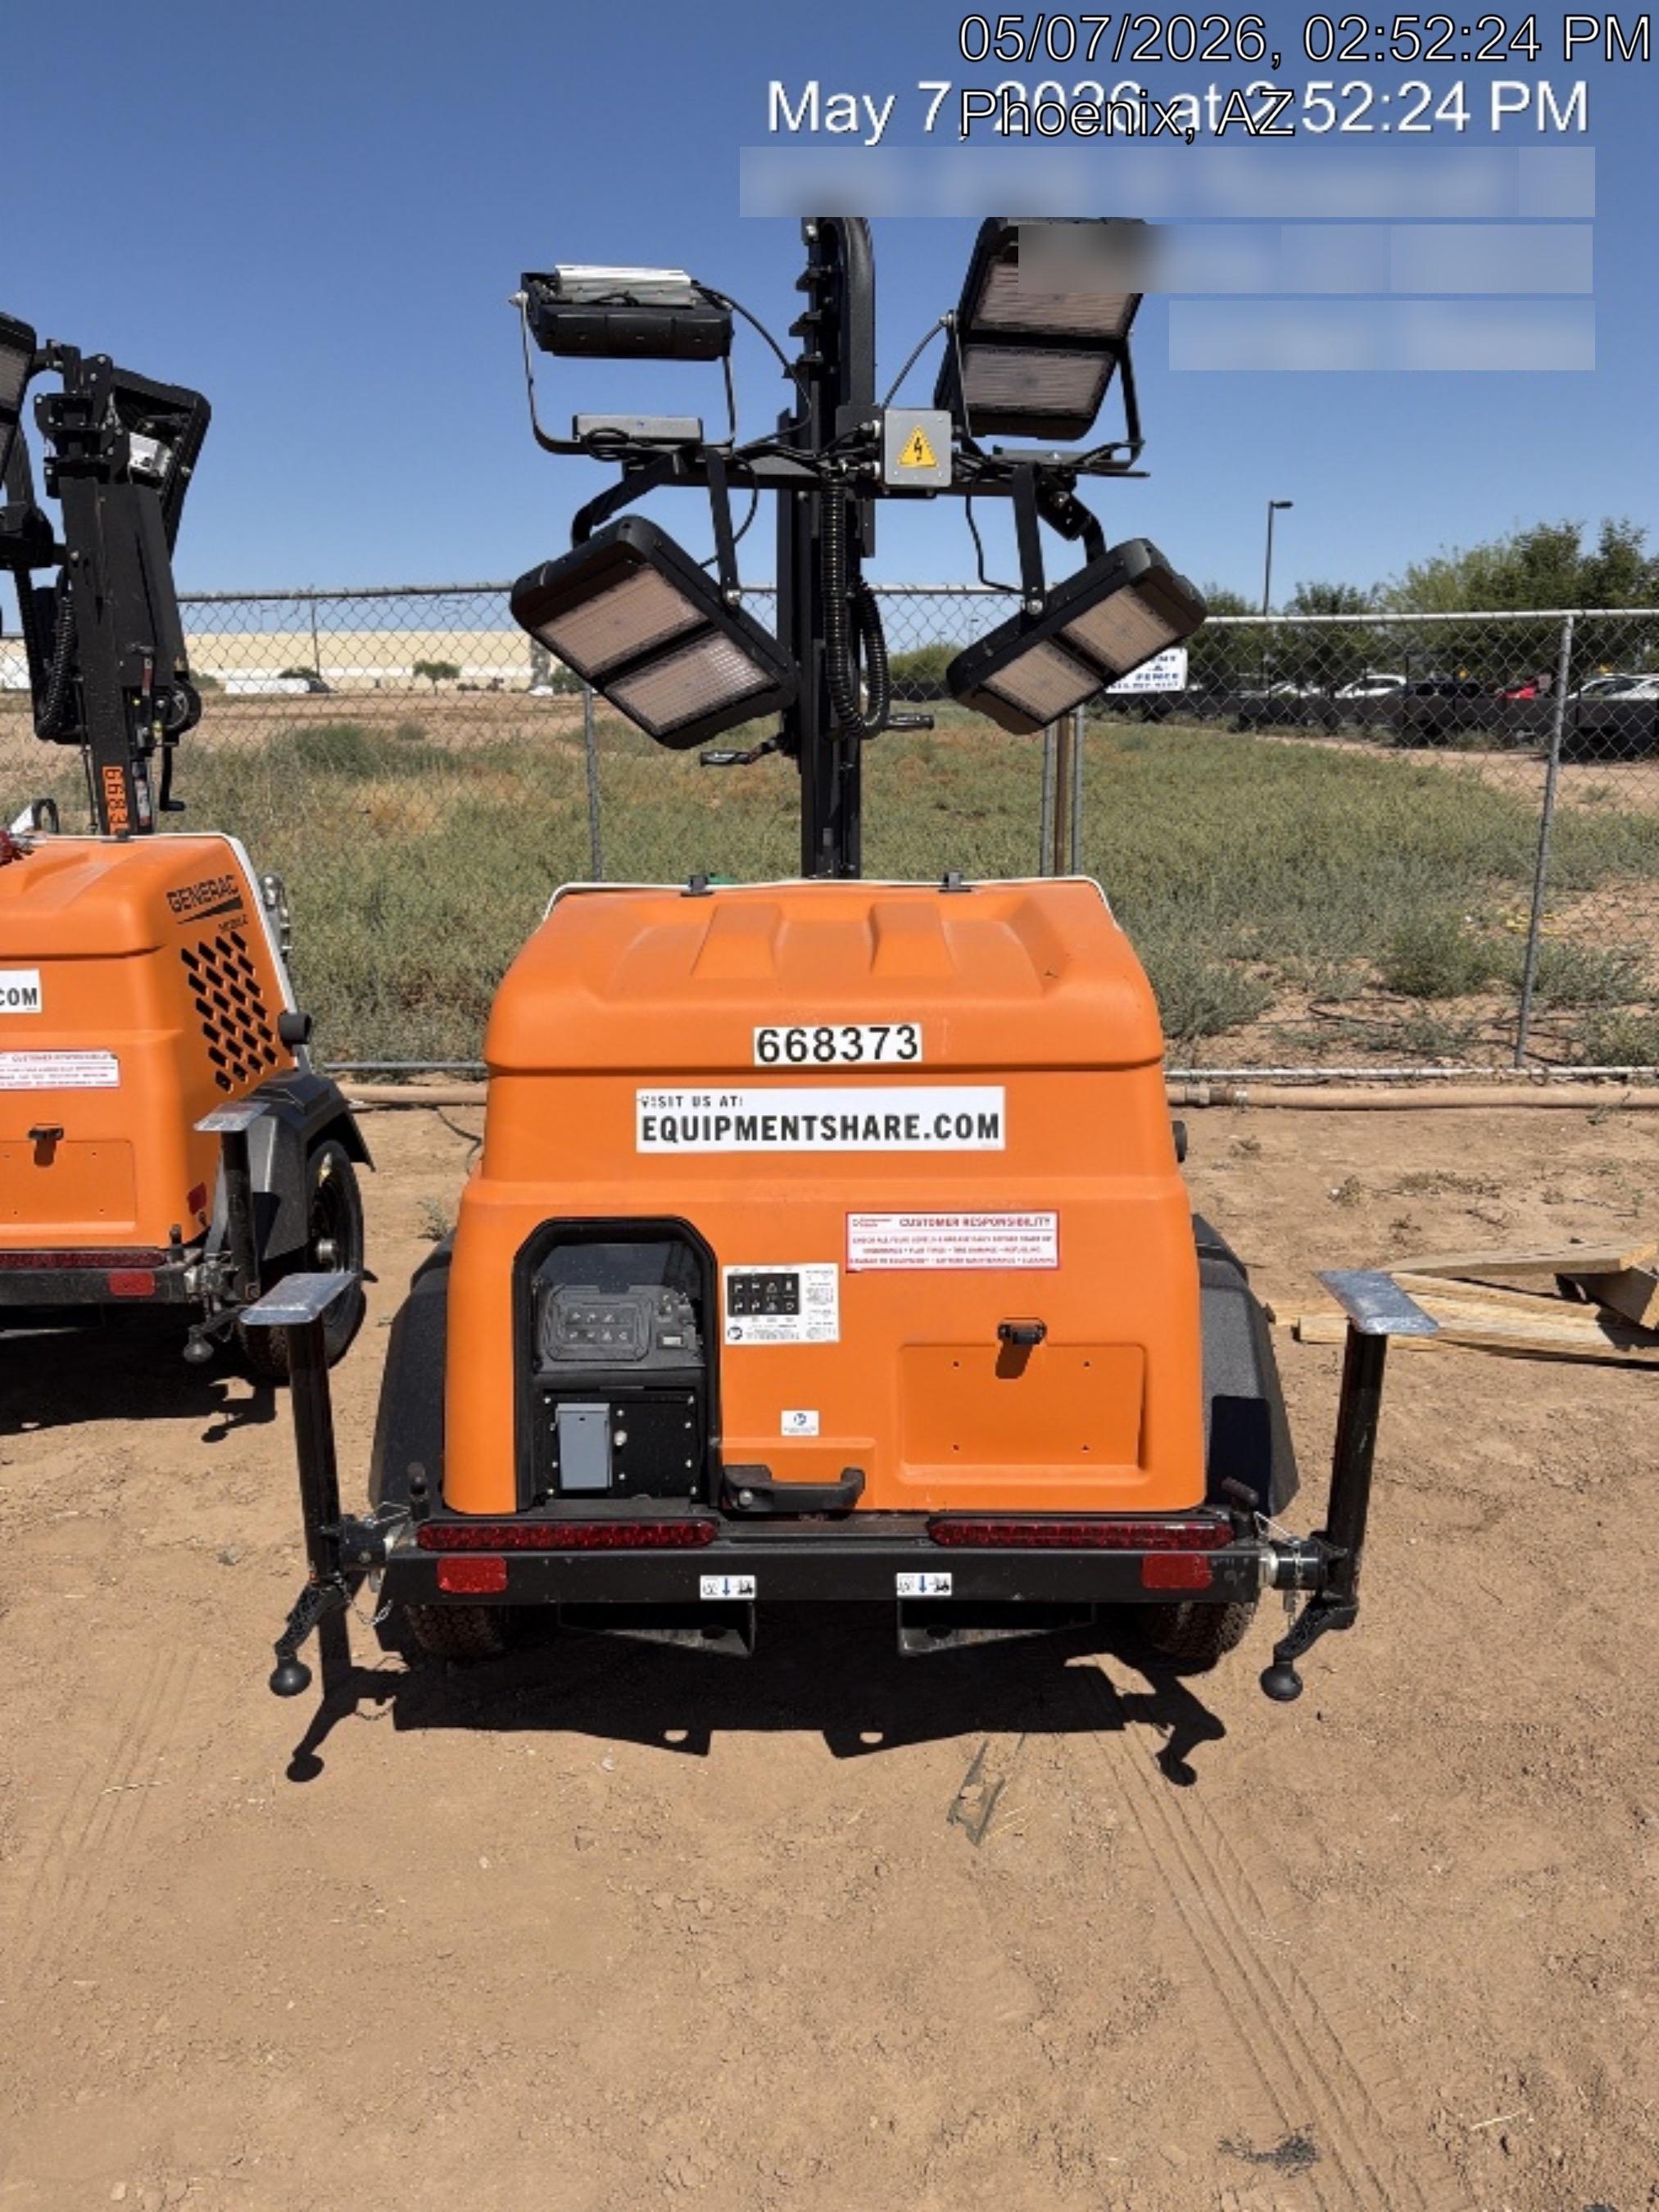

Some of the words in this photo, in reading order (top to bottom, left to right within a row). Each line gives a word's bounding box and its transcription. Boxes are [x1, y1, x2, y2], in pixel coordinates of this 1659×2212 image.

[166, 873, 240, 913] GENERAC
[756, 1024, 919, 1063] 668373
[641, 1095, 685, 1109] VISIT
[691, 1095, 712, 1108] US
[641, 1112, 1000, 1145] EQUIPMENTSHARE.COM
[898, 1217, 960, 1228] CUSTOMER
[962, 1216, 1052, 1227] RESPONSIBILITY
